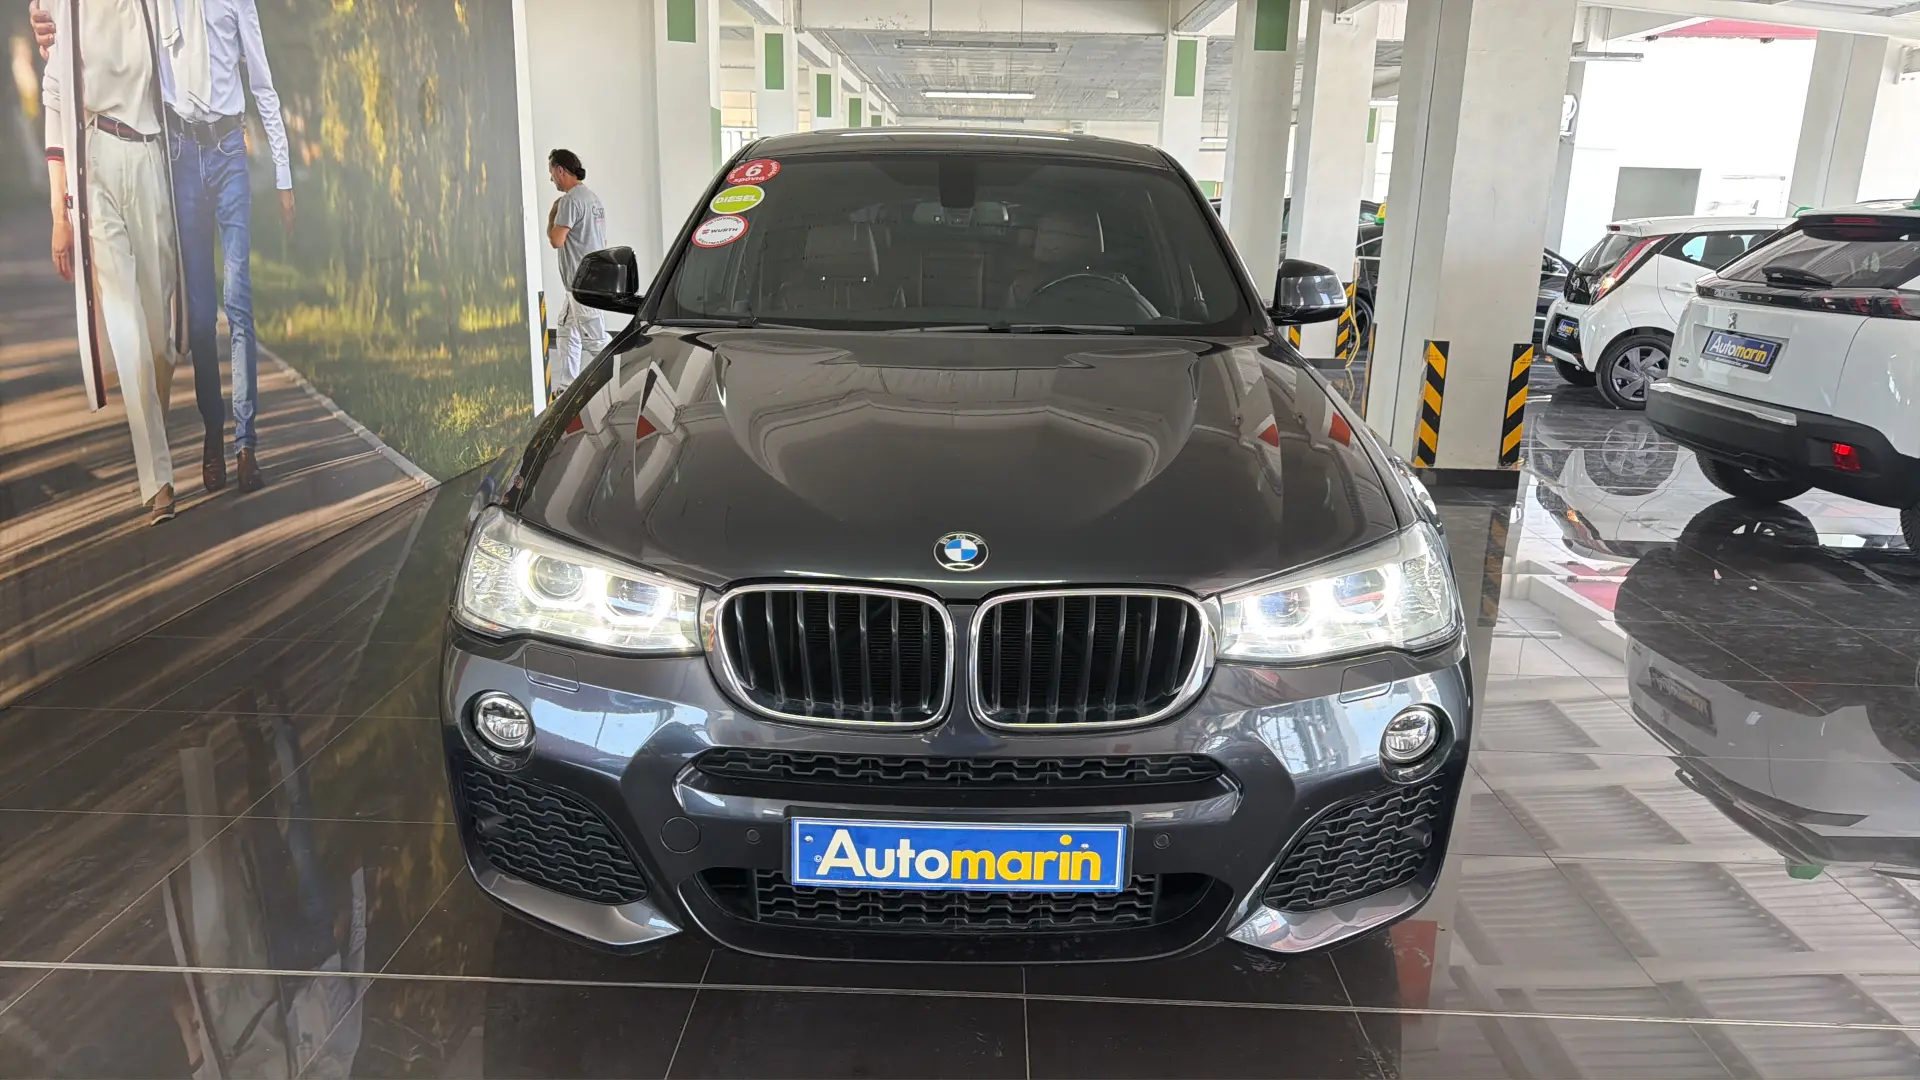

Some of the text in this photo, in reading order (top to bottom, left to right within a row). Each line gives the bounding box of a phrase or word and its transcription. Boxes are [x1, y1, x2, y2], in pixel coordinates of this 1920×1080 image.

[745, 163, 764, 177] 6
[714, 194, 757, 204] DIESEL
[1710, 335, 1768, 363] Automarin
[815, 828, 1102, 882] Automarin
